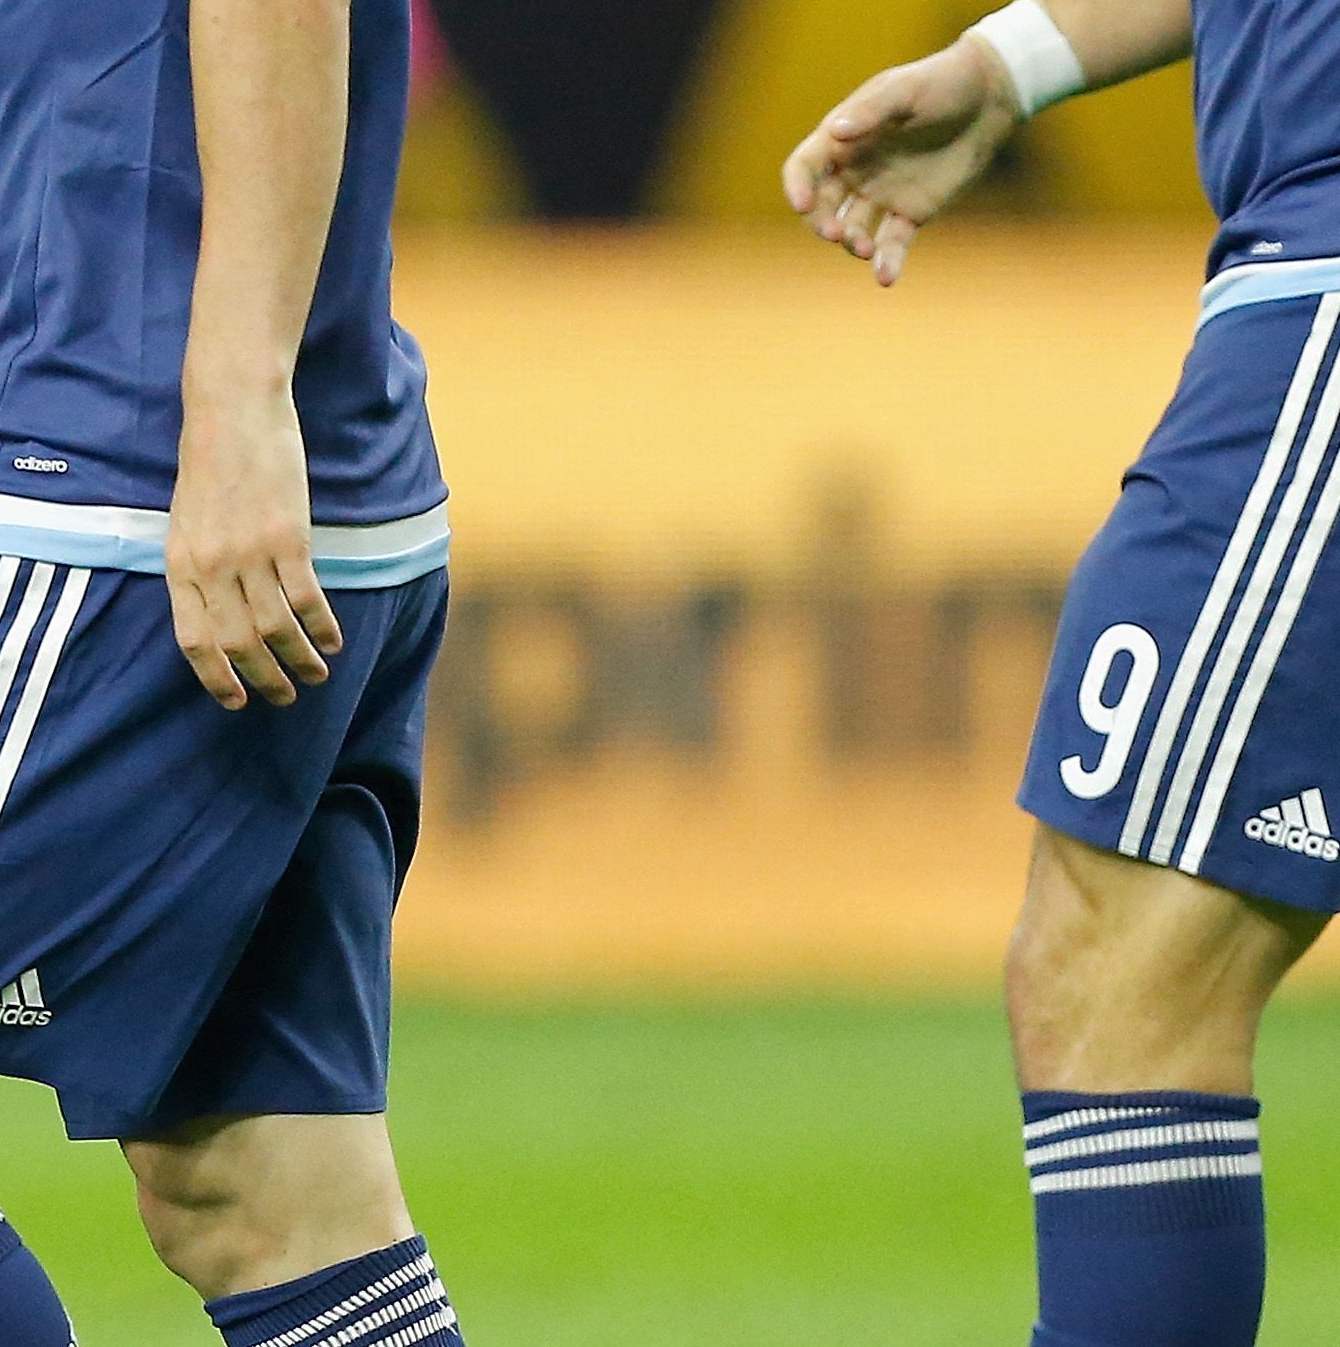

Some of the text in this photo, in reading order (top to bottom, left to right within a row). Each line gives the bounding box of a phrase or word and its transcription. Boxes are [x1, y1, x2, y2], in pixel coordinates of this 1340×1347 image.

[13, 456, 68, 473] adizero
[1060, 623, 1159, 799] 9
[1244, 817, 1340, 861] adidas
